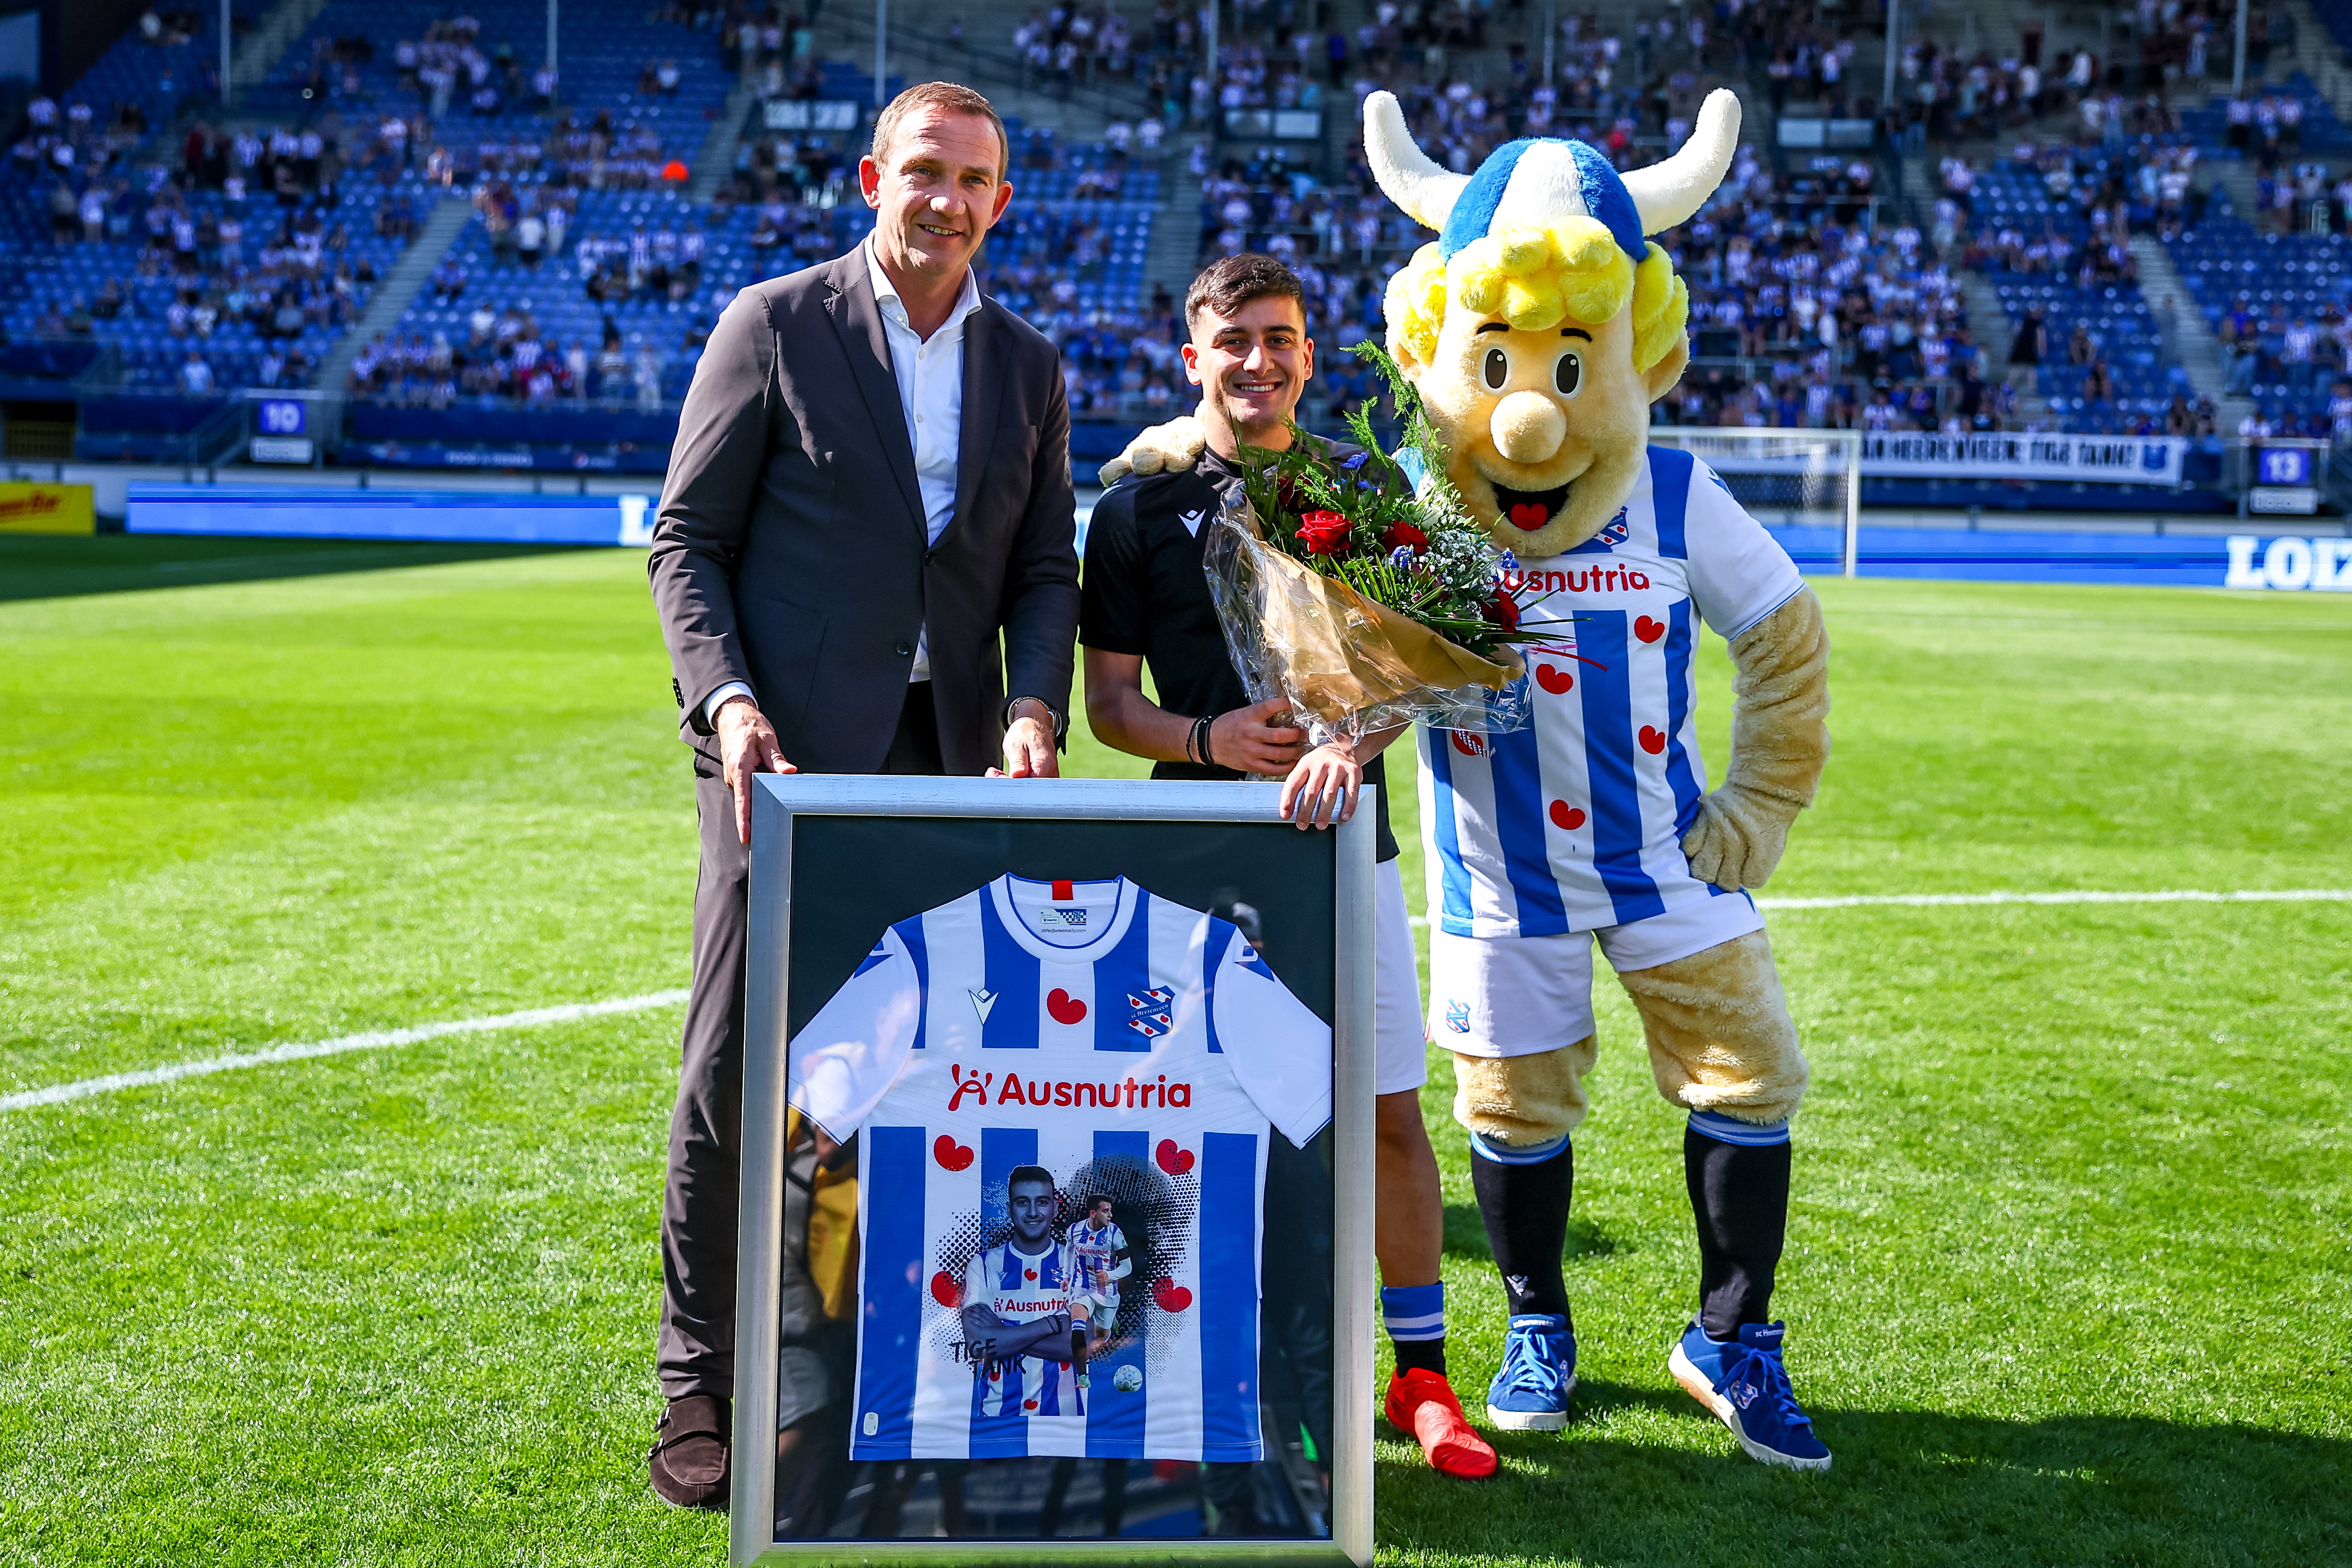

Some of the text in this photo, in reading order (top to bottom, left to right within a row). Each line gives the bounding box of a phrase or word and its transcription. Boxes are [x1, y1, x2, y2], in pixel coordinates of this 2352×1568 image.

[263, 402, 300, 433] 10
[2266, 451, 2301, 482] 13
[1503, 563, 1650, 592] usnutria
[1137, 1004, 1168, 1016] Heerenveen
[997, 1073, 1191, 1108] Ausnutria
[948, 1338, 997, 1363] TIGE
[968, 1353, 1027, 1381] TANK
